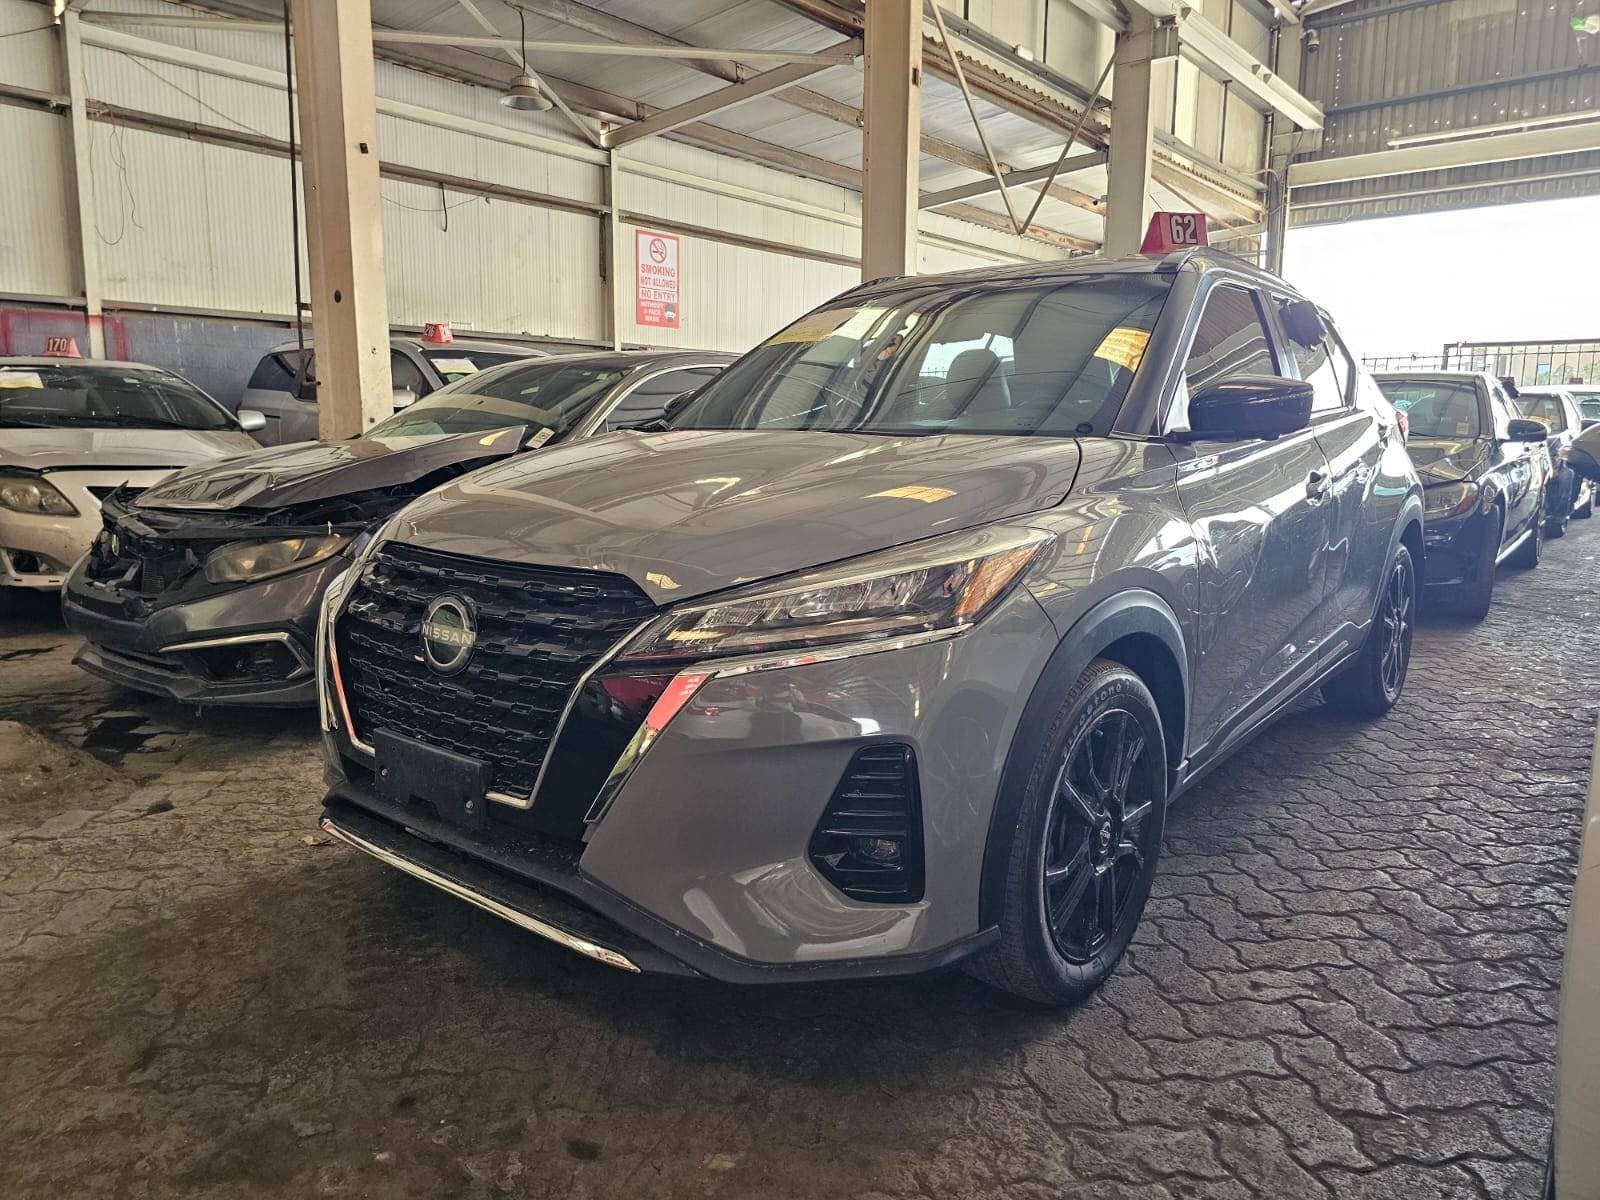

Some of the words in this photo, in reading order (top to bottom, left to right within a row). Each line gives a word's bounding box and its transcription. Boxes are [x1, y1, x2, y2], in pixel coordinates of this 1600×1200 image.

[1170, 215, 1197, 244] 62
[640, 264, 676, 277] SMOKING
[640, 276, 652, 286] NOT
[652, 278, 676, 289] ALLOWED
[641, 289, 652, 299] NO
[653, 290, 676, 302] ENTRY
[48, 339, 67, 351] 170
[422, 623, 472, 645] NISSAN
